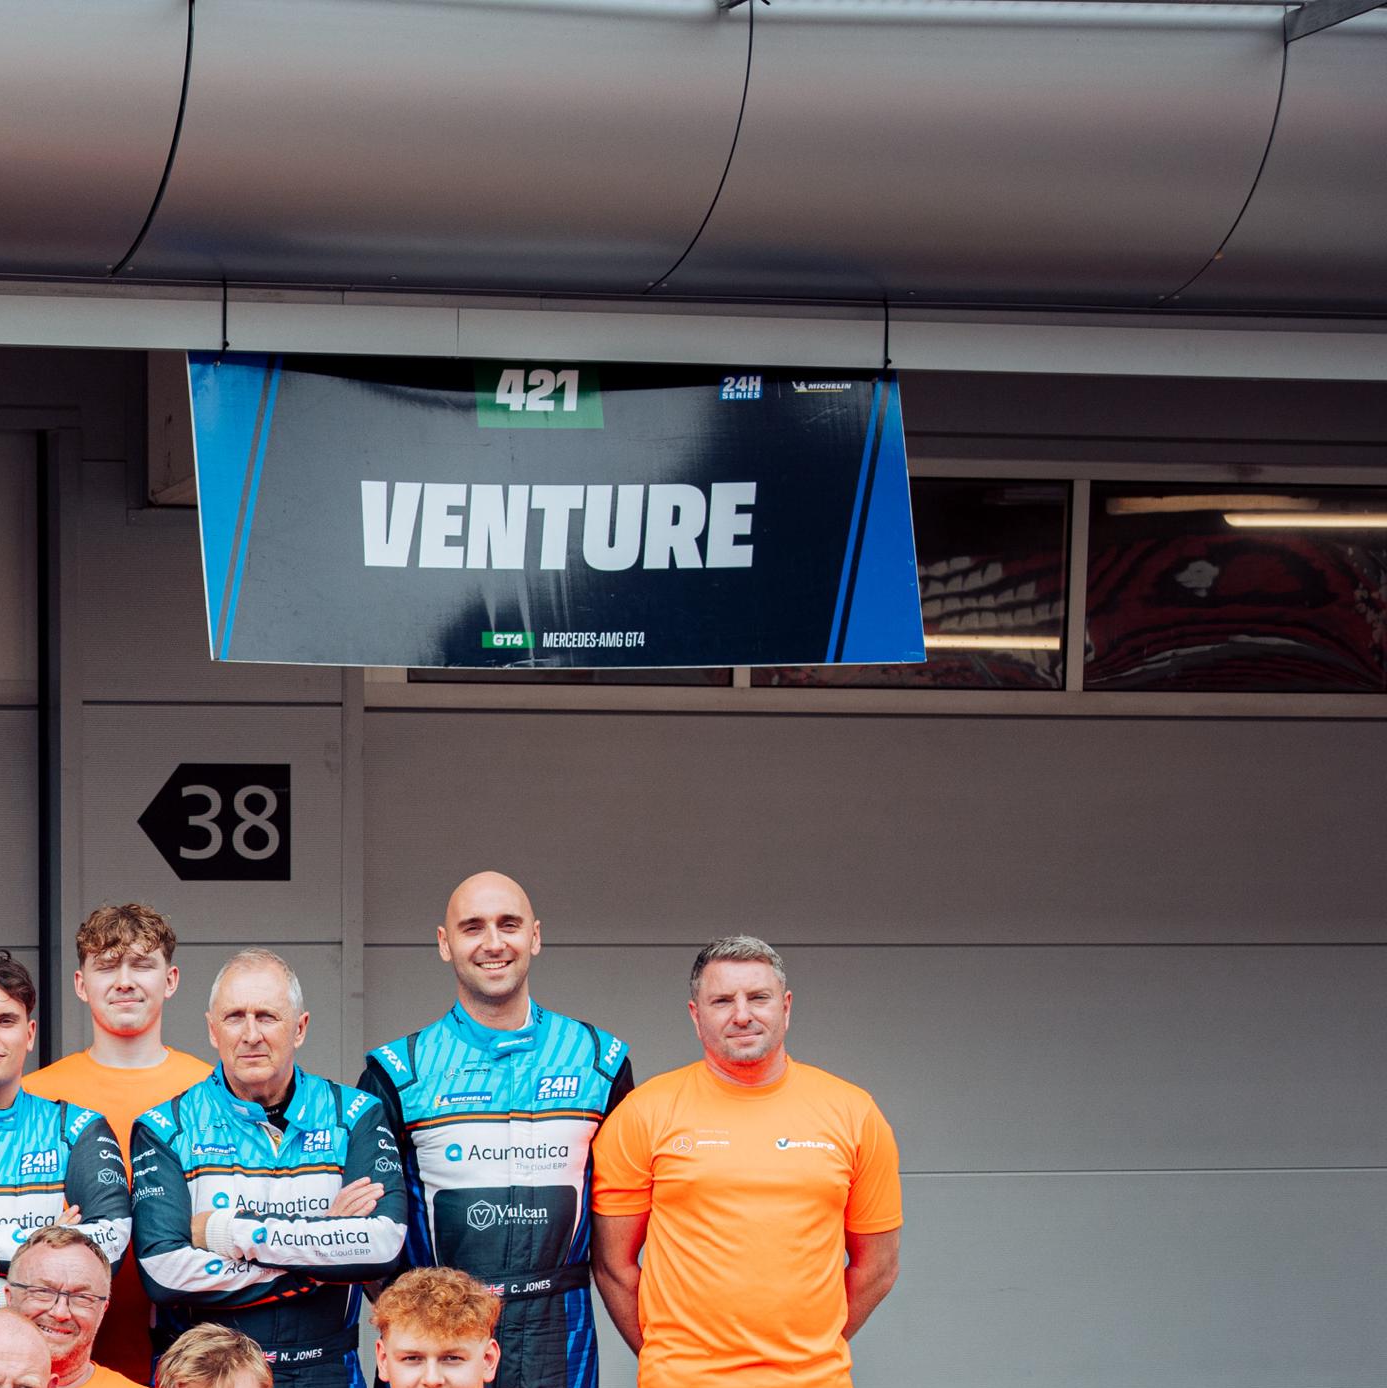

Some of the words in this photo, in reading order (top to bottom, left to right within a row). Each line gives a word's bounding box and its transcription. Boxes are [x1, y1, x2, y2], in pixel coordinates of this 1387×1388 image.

[494, 369, 580, 412] 421
[722, 375, 762, 393] 24H
[807, 381, 853, 391] MICHELIN
[721, 390, 762, 400] SERIES
[360, 480, 758, 571] VENTURE
[492, 634, 523, 646] GT4
[542, 632, 622, 649] MERCEDES-AMG
[624, 632, 645, 648] GT4
[180, 785, 279, 860] 38
[539, 1076, 579, 1093] 24H
[537, 1091, 577, 1100] SERIES
[776, 1137, 836, 1150] Venture
[21, 1150, 58, 1168] 24H
[553, 1162, 567, 1170] ERP
[21, 1165, 58, 1175] SERIES
[235, 1194, 329, 1214] Acumatica
[495, 1203, 547, 1219] Vulcan
[270, 1229, 369, 1247] Acumatica
[327, 1249, 353, 1257] Cloud
[523, 1280, 551, 1293] JONES
[293, 1348, 323, 1361] JONES
